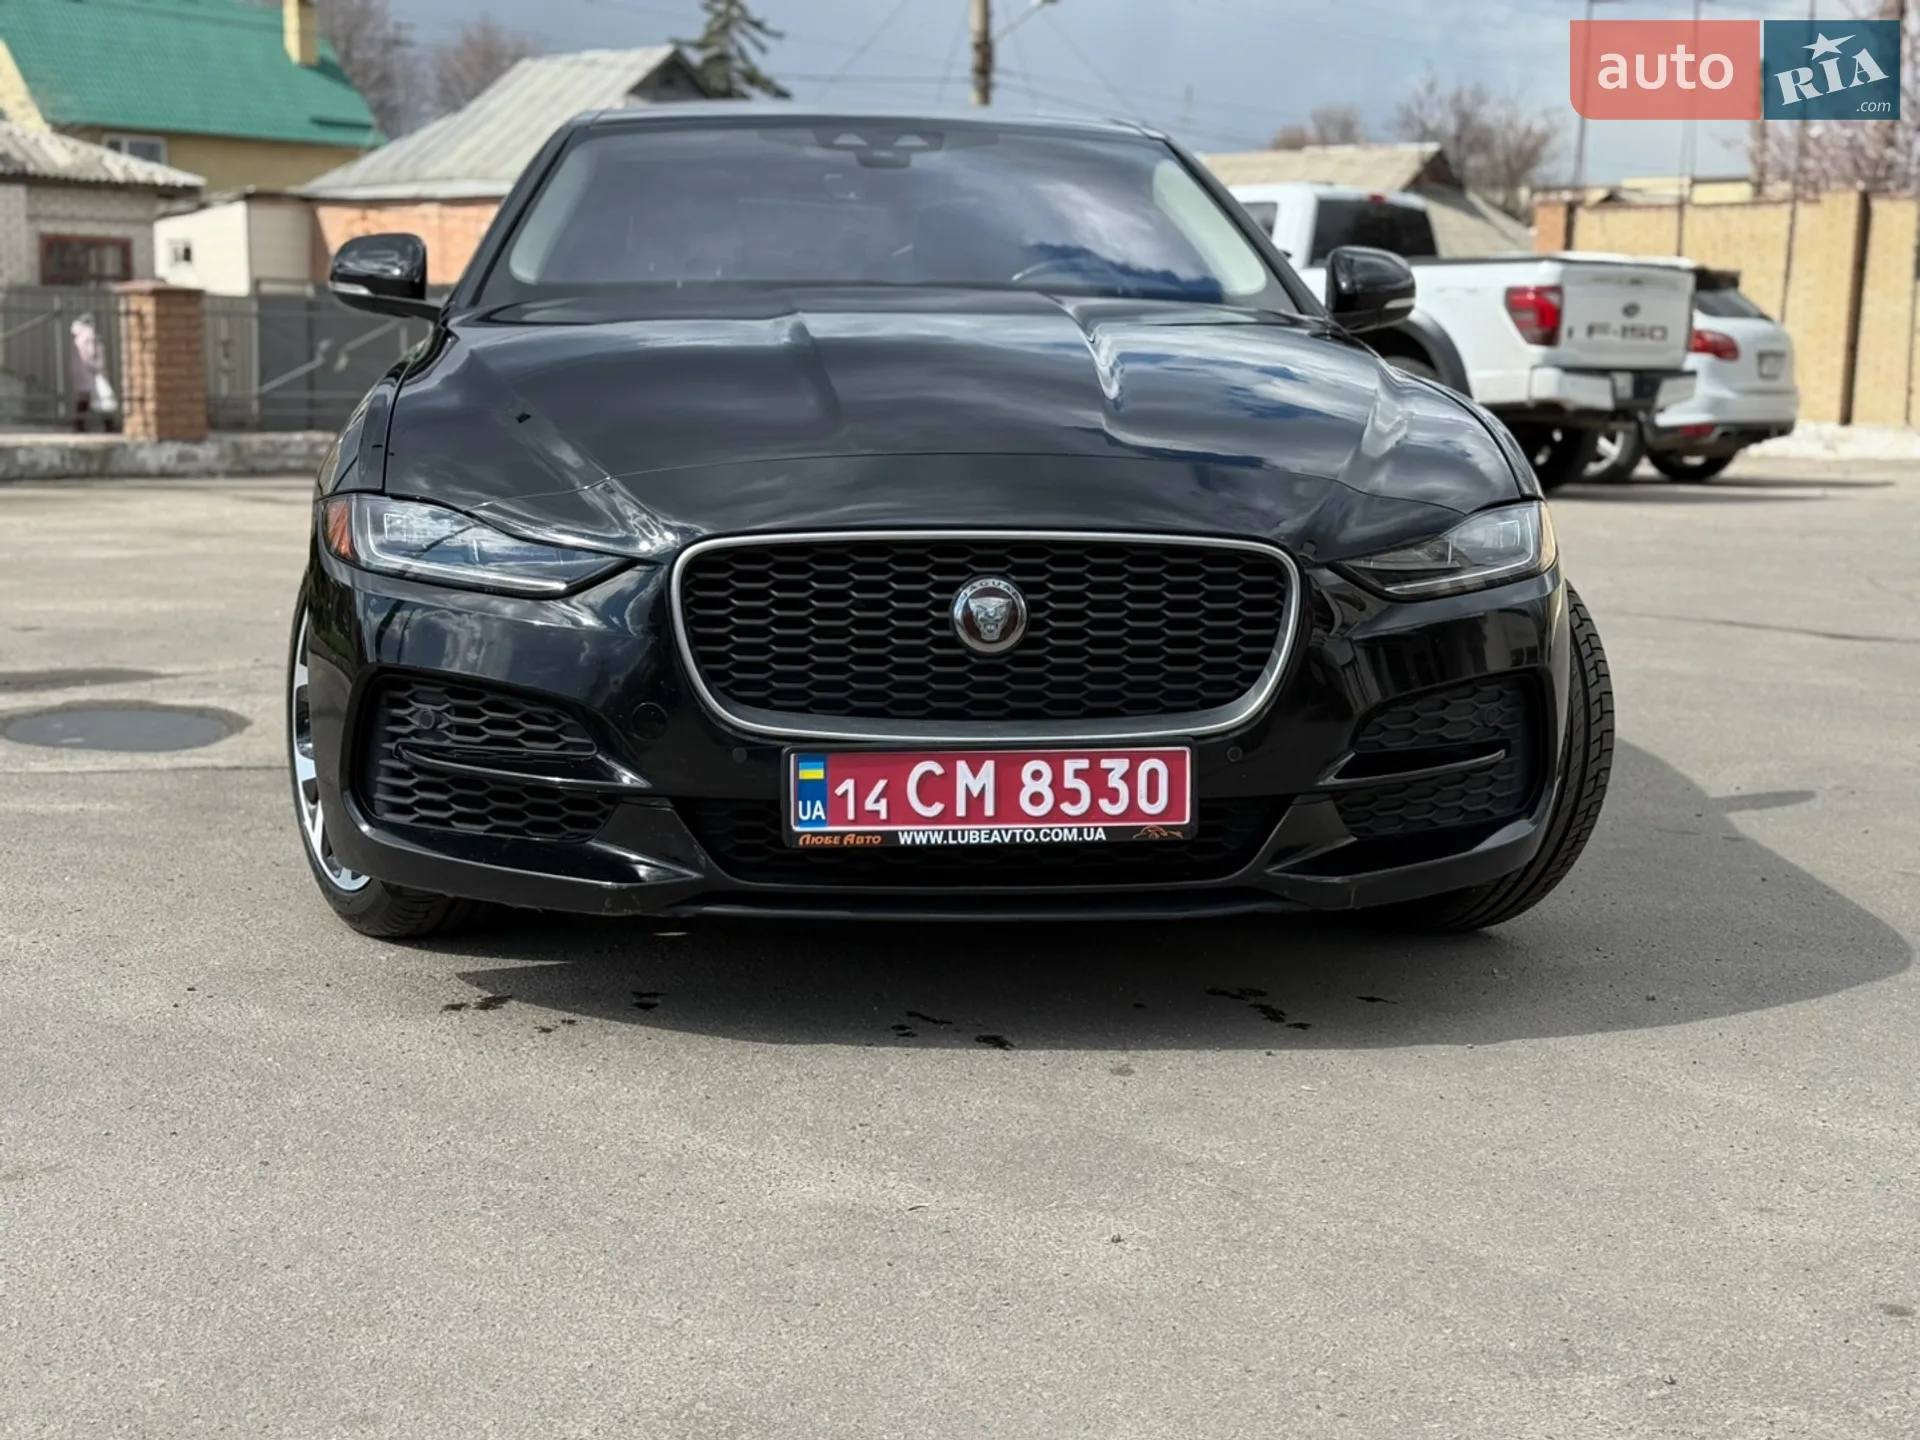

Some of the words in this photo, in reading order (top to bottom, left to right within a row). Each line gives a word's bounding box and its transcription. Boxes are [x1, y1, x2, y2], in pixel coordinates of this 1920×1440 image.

[1586, 323, 1669, 341] F-150
[834, 778, 889, 820] 14
[906, 759, 996, 817] CM
[1019, 758, 1169, 817] 8530
[798, 800, 826, 820] UA
[898, 827, 1106, 845] WWW.LUBEAVTO.COM.UA
